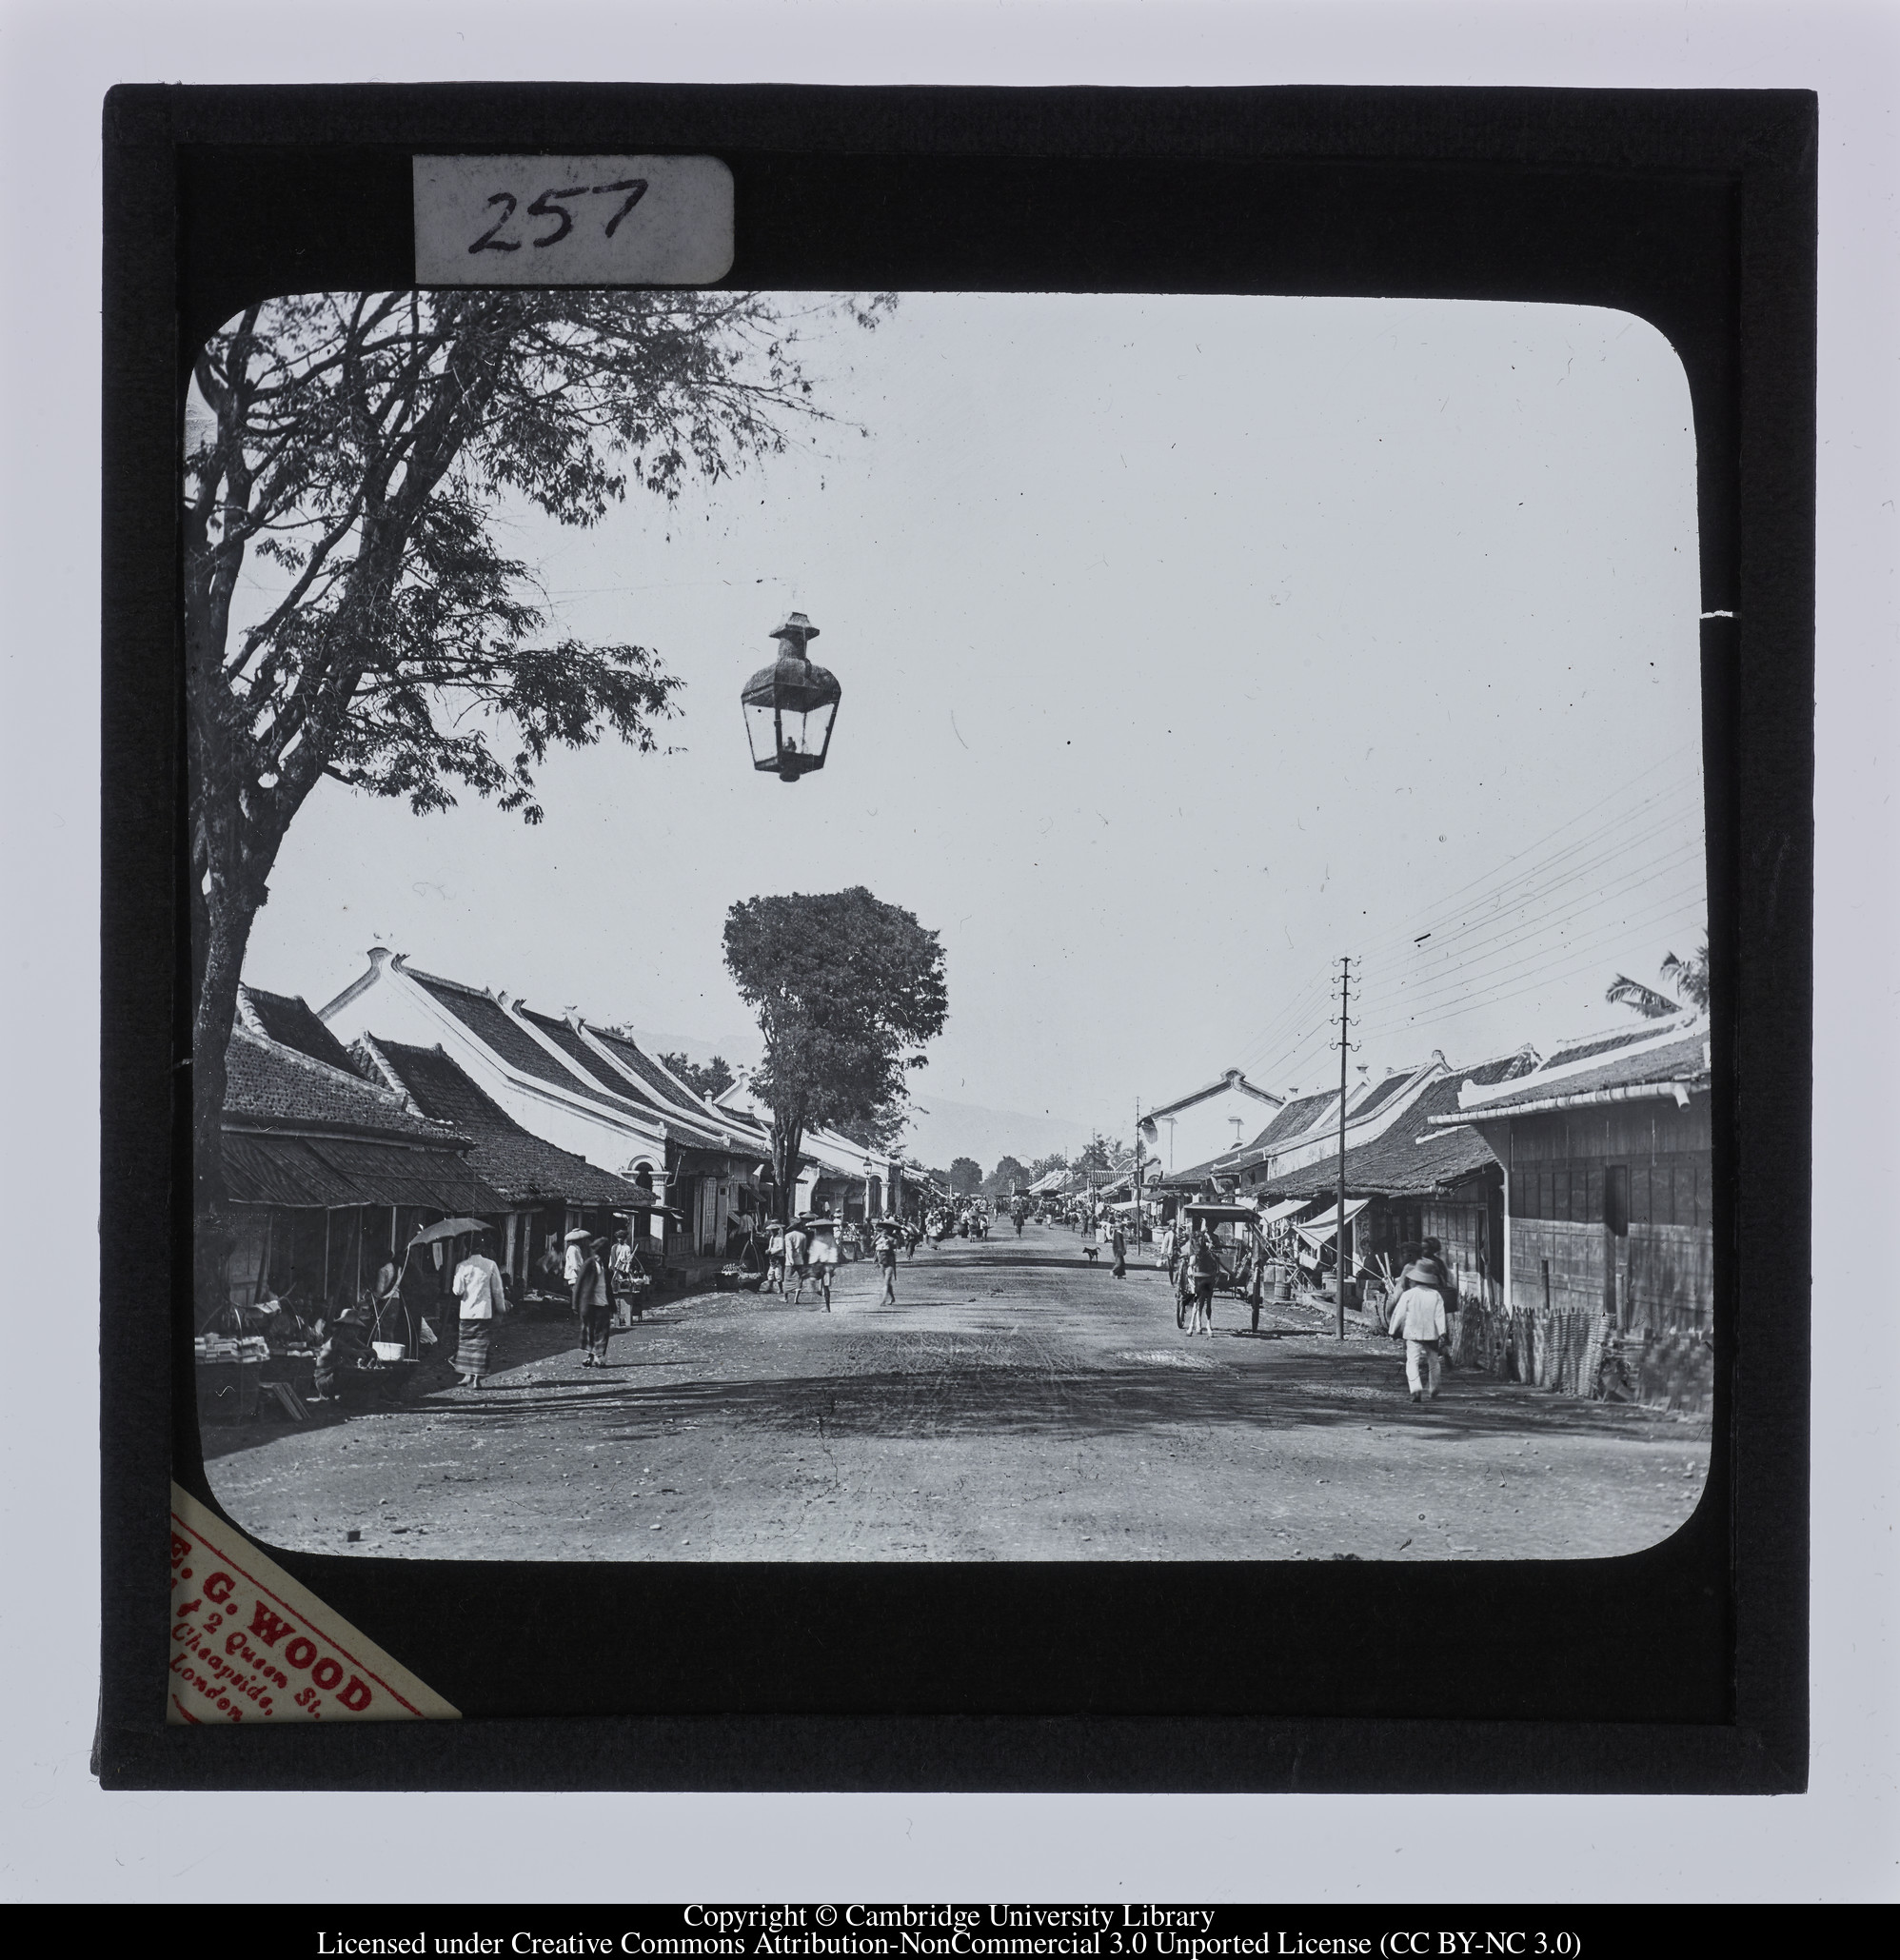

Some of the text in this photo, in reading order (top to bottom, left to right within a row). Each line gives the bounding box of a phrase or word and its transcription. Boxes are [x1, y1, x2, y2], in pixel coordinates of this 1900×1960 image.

[468, 178, 649, 255] 257
[170, 1653, 244, 1722] London
[171, 1622, 273, 1716] Cheapside,
[203, 1572, 239, 1615] G.
[247, 1599, 373, 1712] WOOD
[203, 1612, 224, 1635] 2
[225, 1632, 287, 1690] Queen
[294, 1687, 321, 1719] St.
